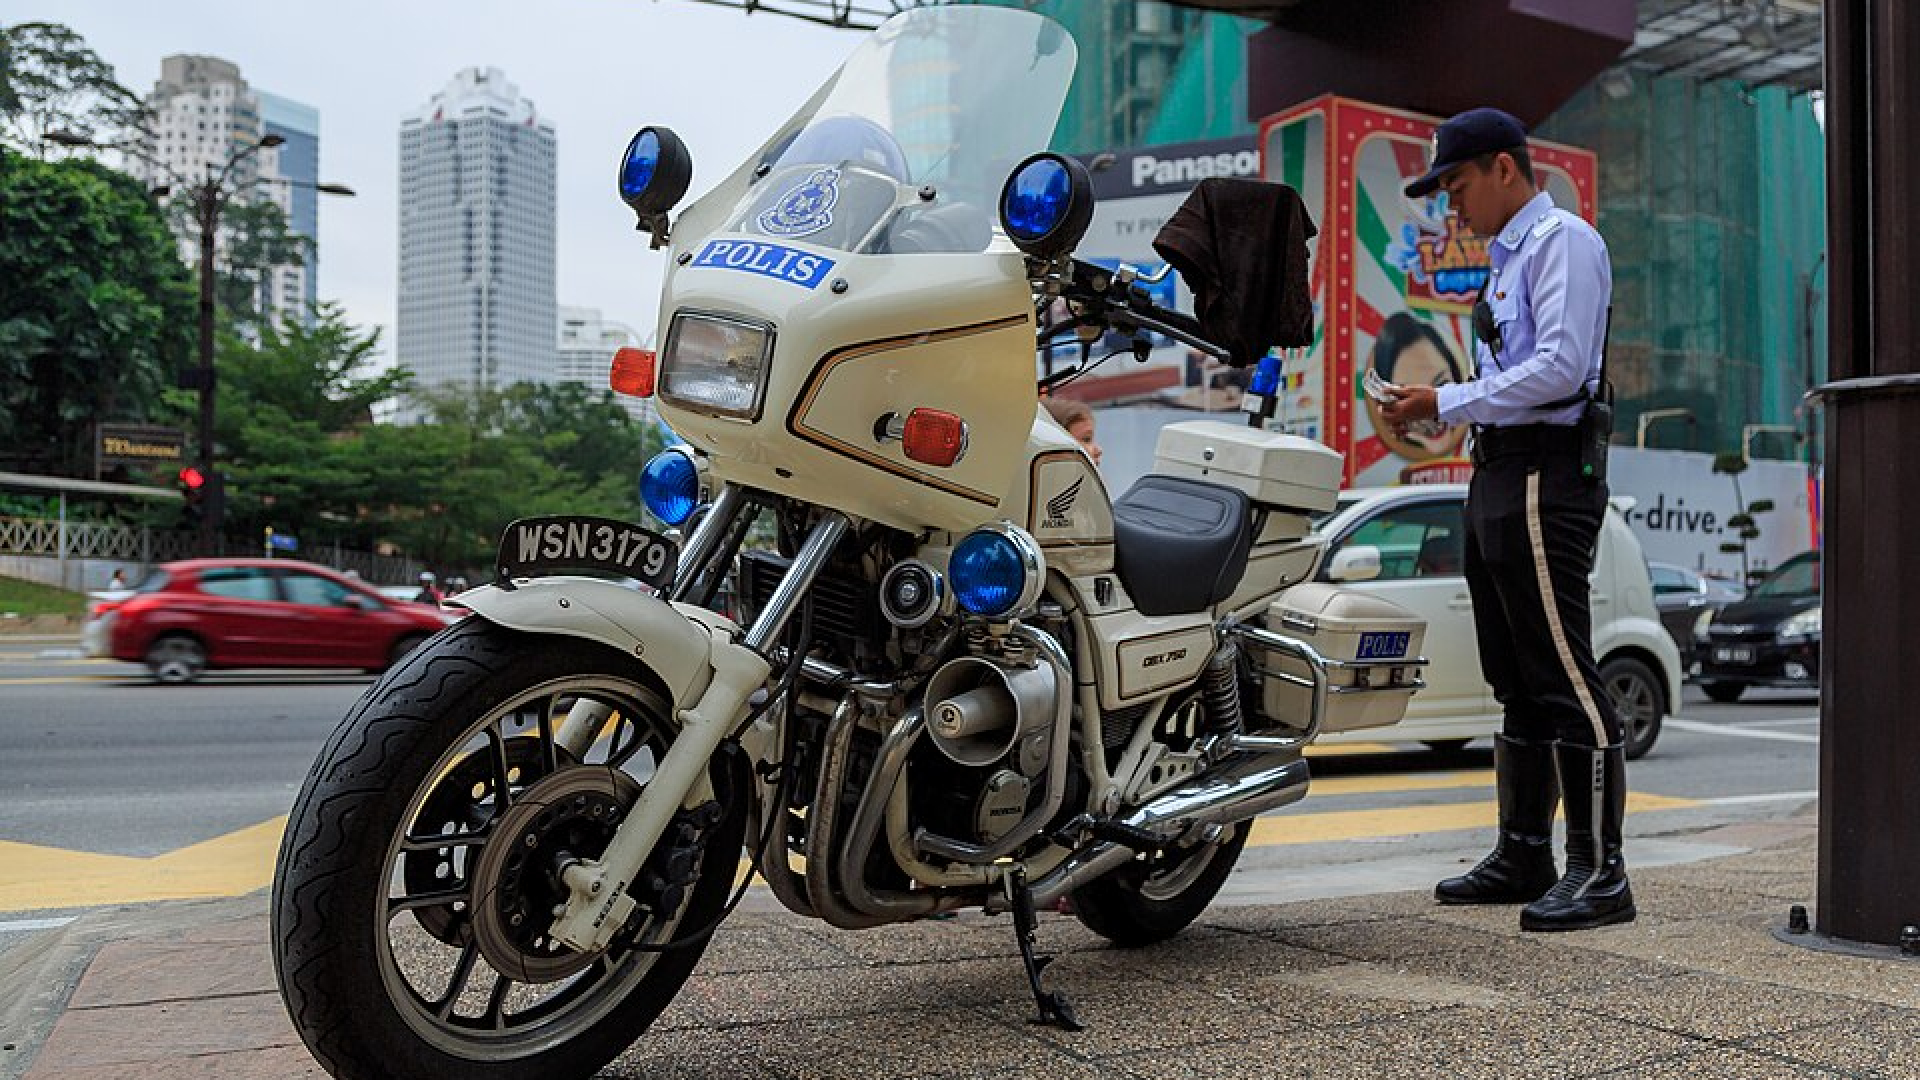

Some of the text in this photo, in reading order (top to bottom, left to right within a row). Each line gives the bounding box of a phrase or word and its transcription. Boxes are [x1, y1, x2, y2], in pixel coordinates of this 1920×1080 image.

[701, 243, 823, 281] POLIS
[1165, 648, 1187, 663] 750
[1359, 635, 1407, 656] POLIS
